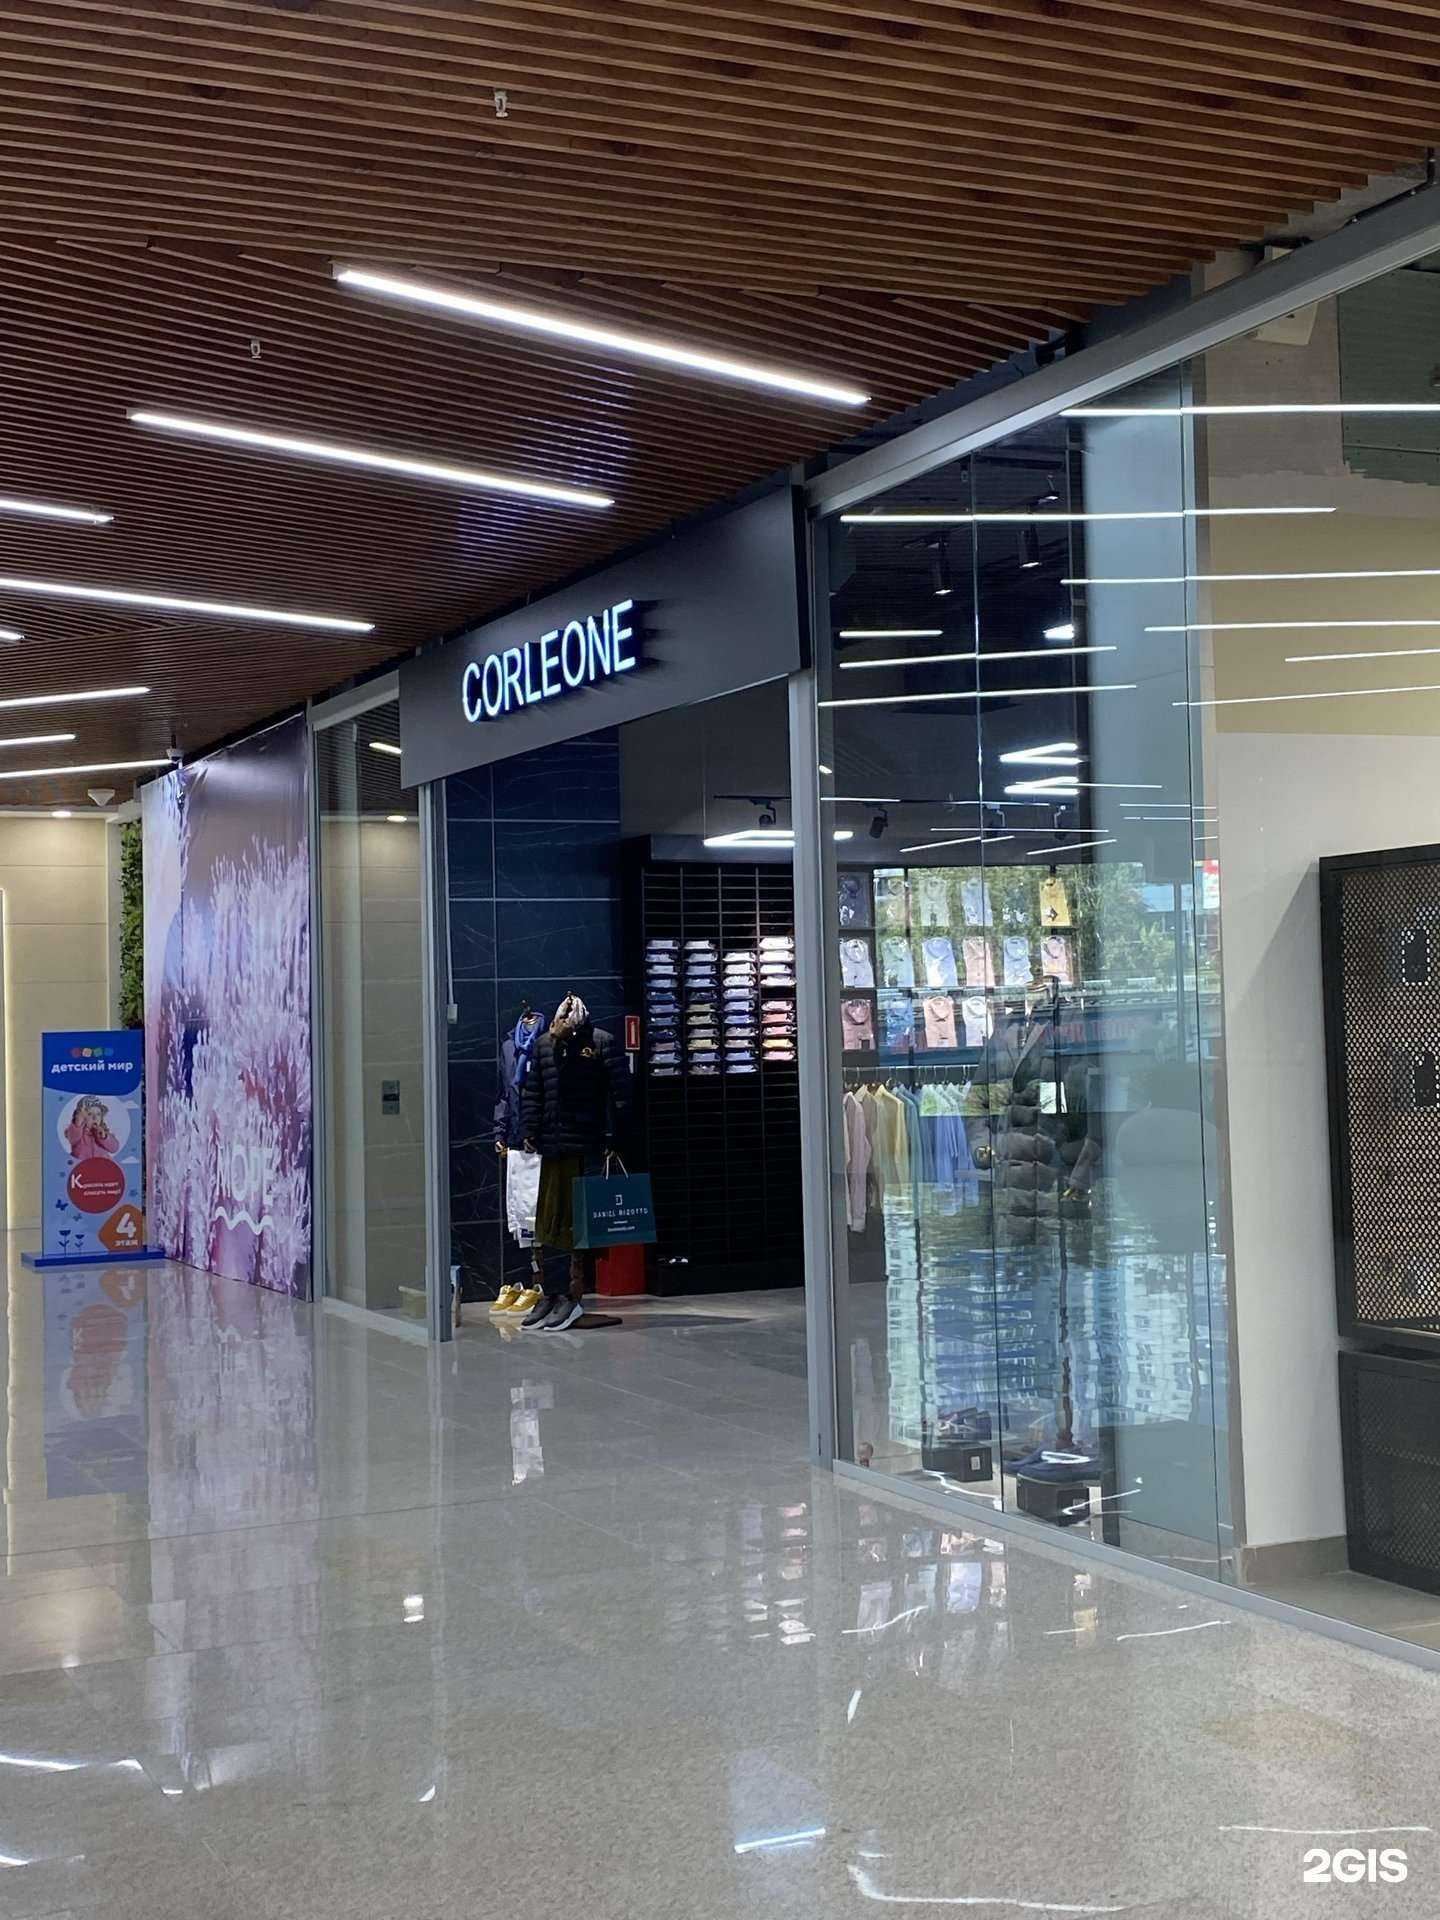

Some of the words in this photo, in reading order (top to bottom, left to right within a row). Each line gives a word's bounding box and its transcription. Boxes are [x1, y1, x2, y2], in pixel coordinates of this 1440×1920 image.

[463, 599, 636, 723] CORLEONE
[51, 1060, 105, 1073] детский
[108, 1062, 134, 1072] мир
[116, 1213, 136, 1238] 4
